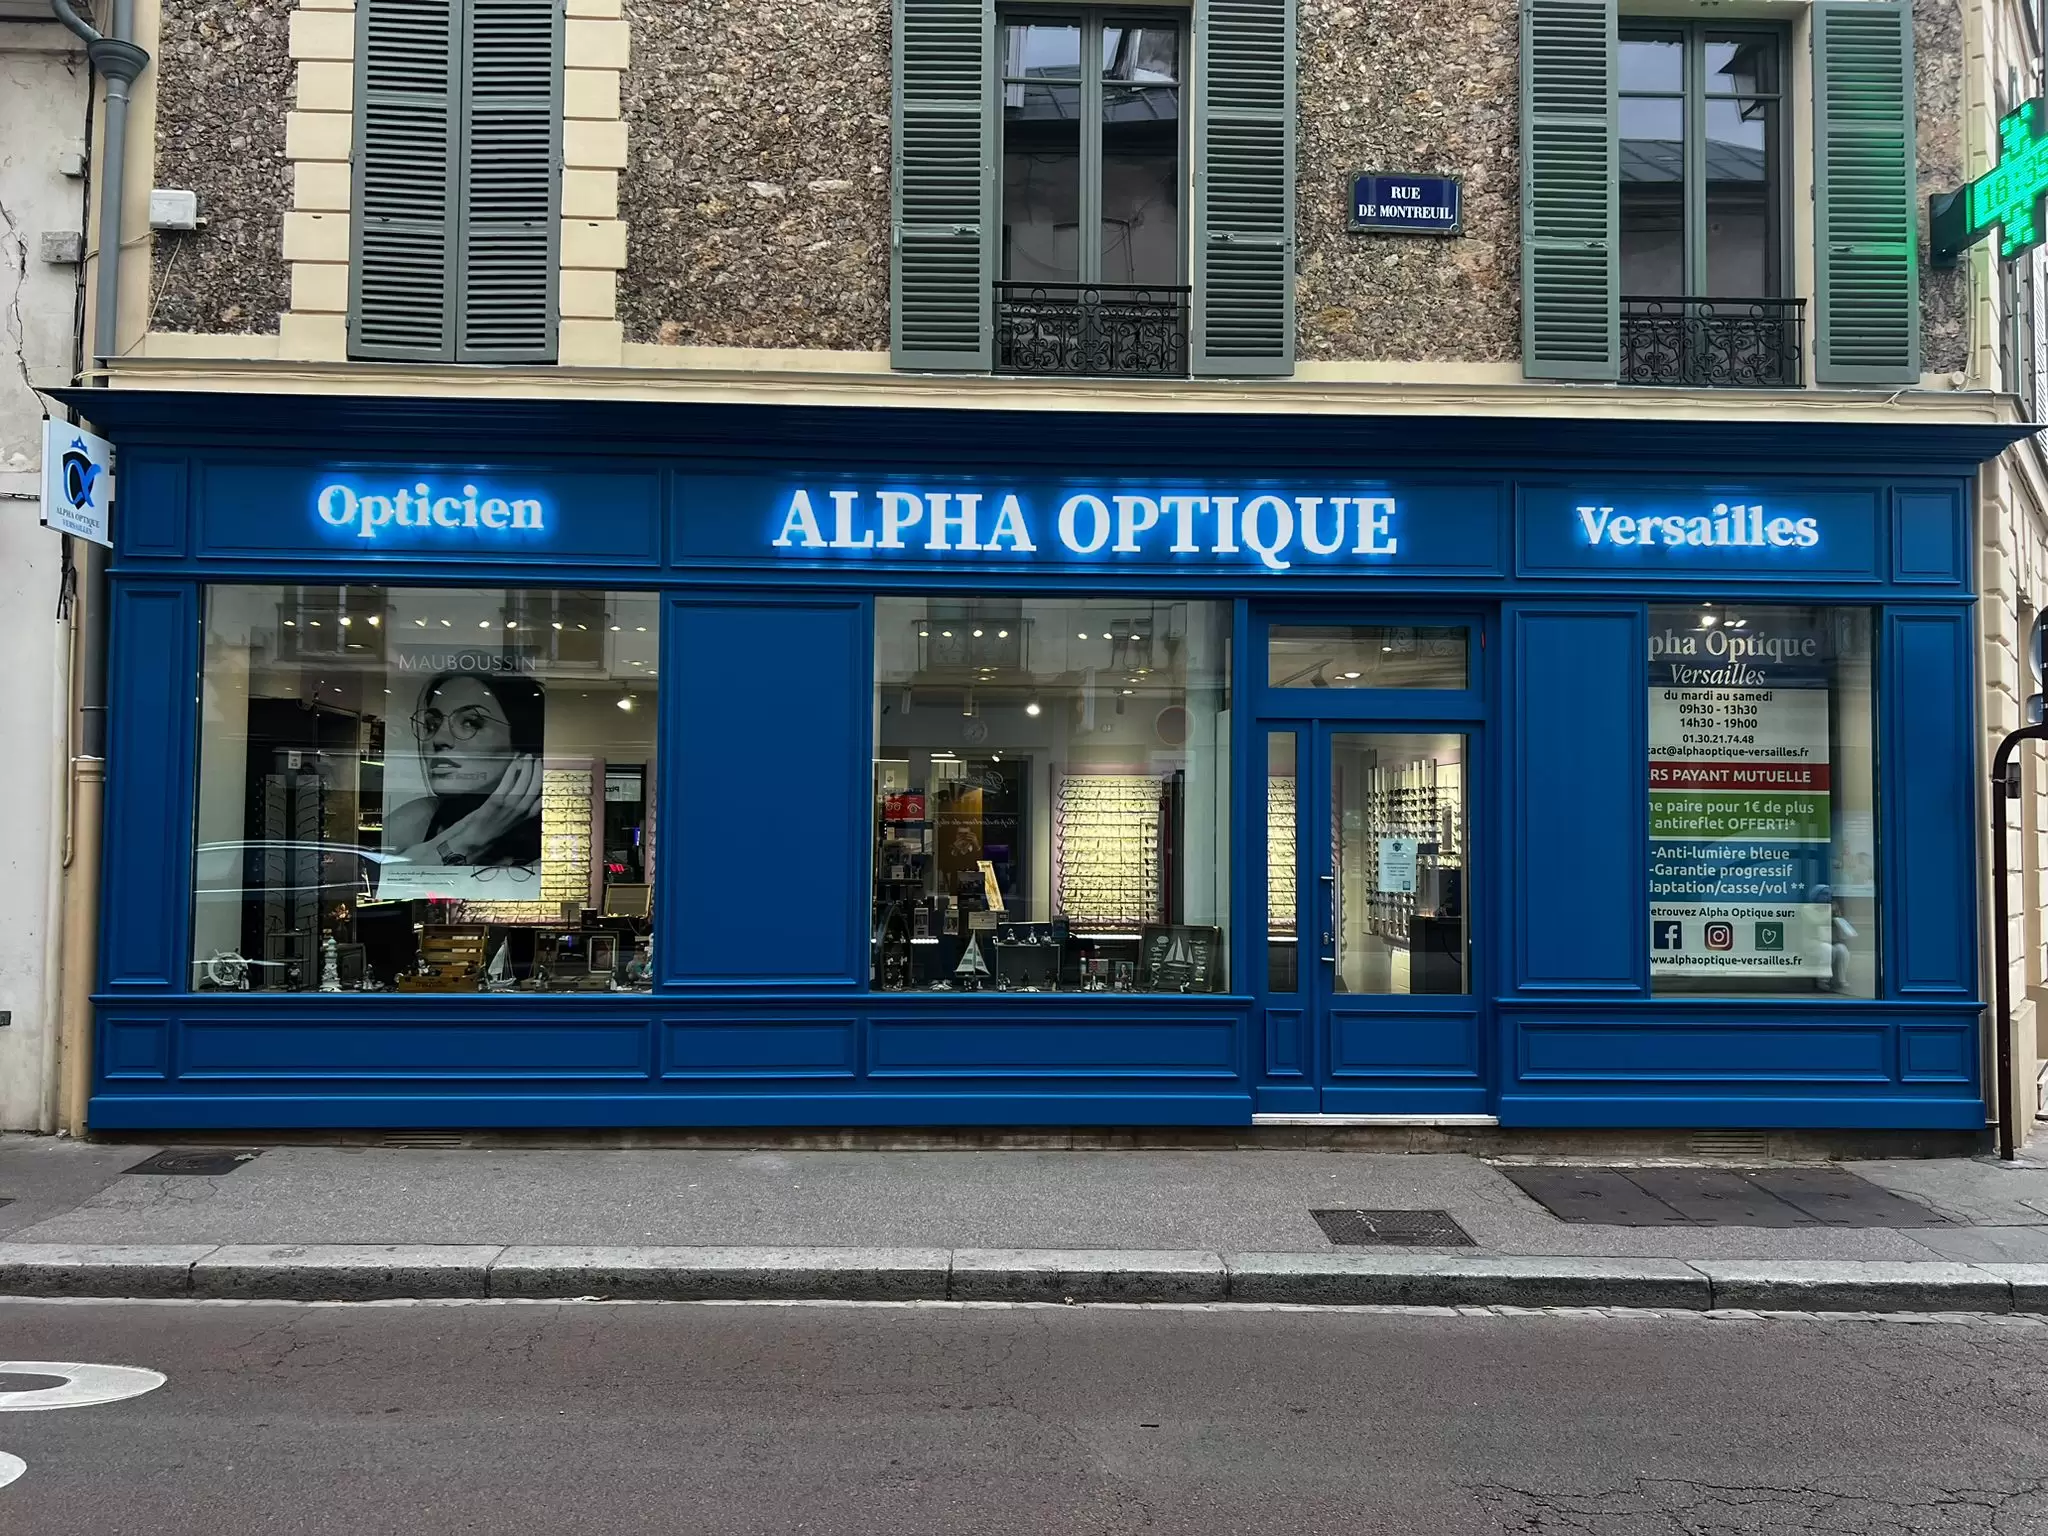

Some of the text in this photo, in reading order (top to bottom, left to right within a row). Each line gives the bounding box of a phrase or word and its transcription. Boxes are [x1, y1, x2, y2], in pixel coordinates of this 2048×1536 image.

[1391, 186, 1421, 199] RUE
[1358, 204, 1454, 219] DE MONTREUIL
[56, 506, 100, 528] ALPHA OPTIQUE
[318, 483, 544, 537] Opticien
[62, 519, 93, 535] VERSAILLES
[772, 489, 1397, 570] ALPHA OPTIQUE
[1576, 503, 1819, 547] Versailles
[1705, 630, 1816, 663] Optique
[399, 654, 536, 670] MAUBOUSSIN
[1671, 663, 1766, 685] Versailles
[1664, 690, 1773, 702] du mardi au samedi
[1679, 704, 1714, 714] 09h30
[1724, 704, 1757, 715] 13h30
[1680, 718, 1714, 728] 14h30
[1724, 718, 1758, 729] 19h00
[1682, 734, 1754, 744] 01.30.21.74.48
[1648, 769, 1811, 783] RS PAYANT MUTUELLE
[1667, 799, 1703, 814] paire
[1707, 802, 1739, 815] pour
[1744, 801, 1760, 813] 1€
[1764, 800, 1781, 813] de
[1785, 801, 1814, 816] plus
[1655, 817, 1724, 829] antireflet
[1651, 846, 1790, 860] -Anti-lumière bleue
[1649, 863, 1793, 879] -Garantie progressif
[1699, 907, 1729, 919] Alpha
[1731, 908, 1774, 919] Optique
[1776, 909, 1796, 918] sur:
